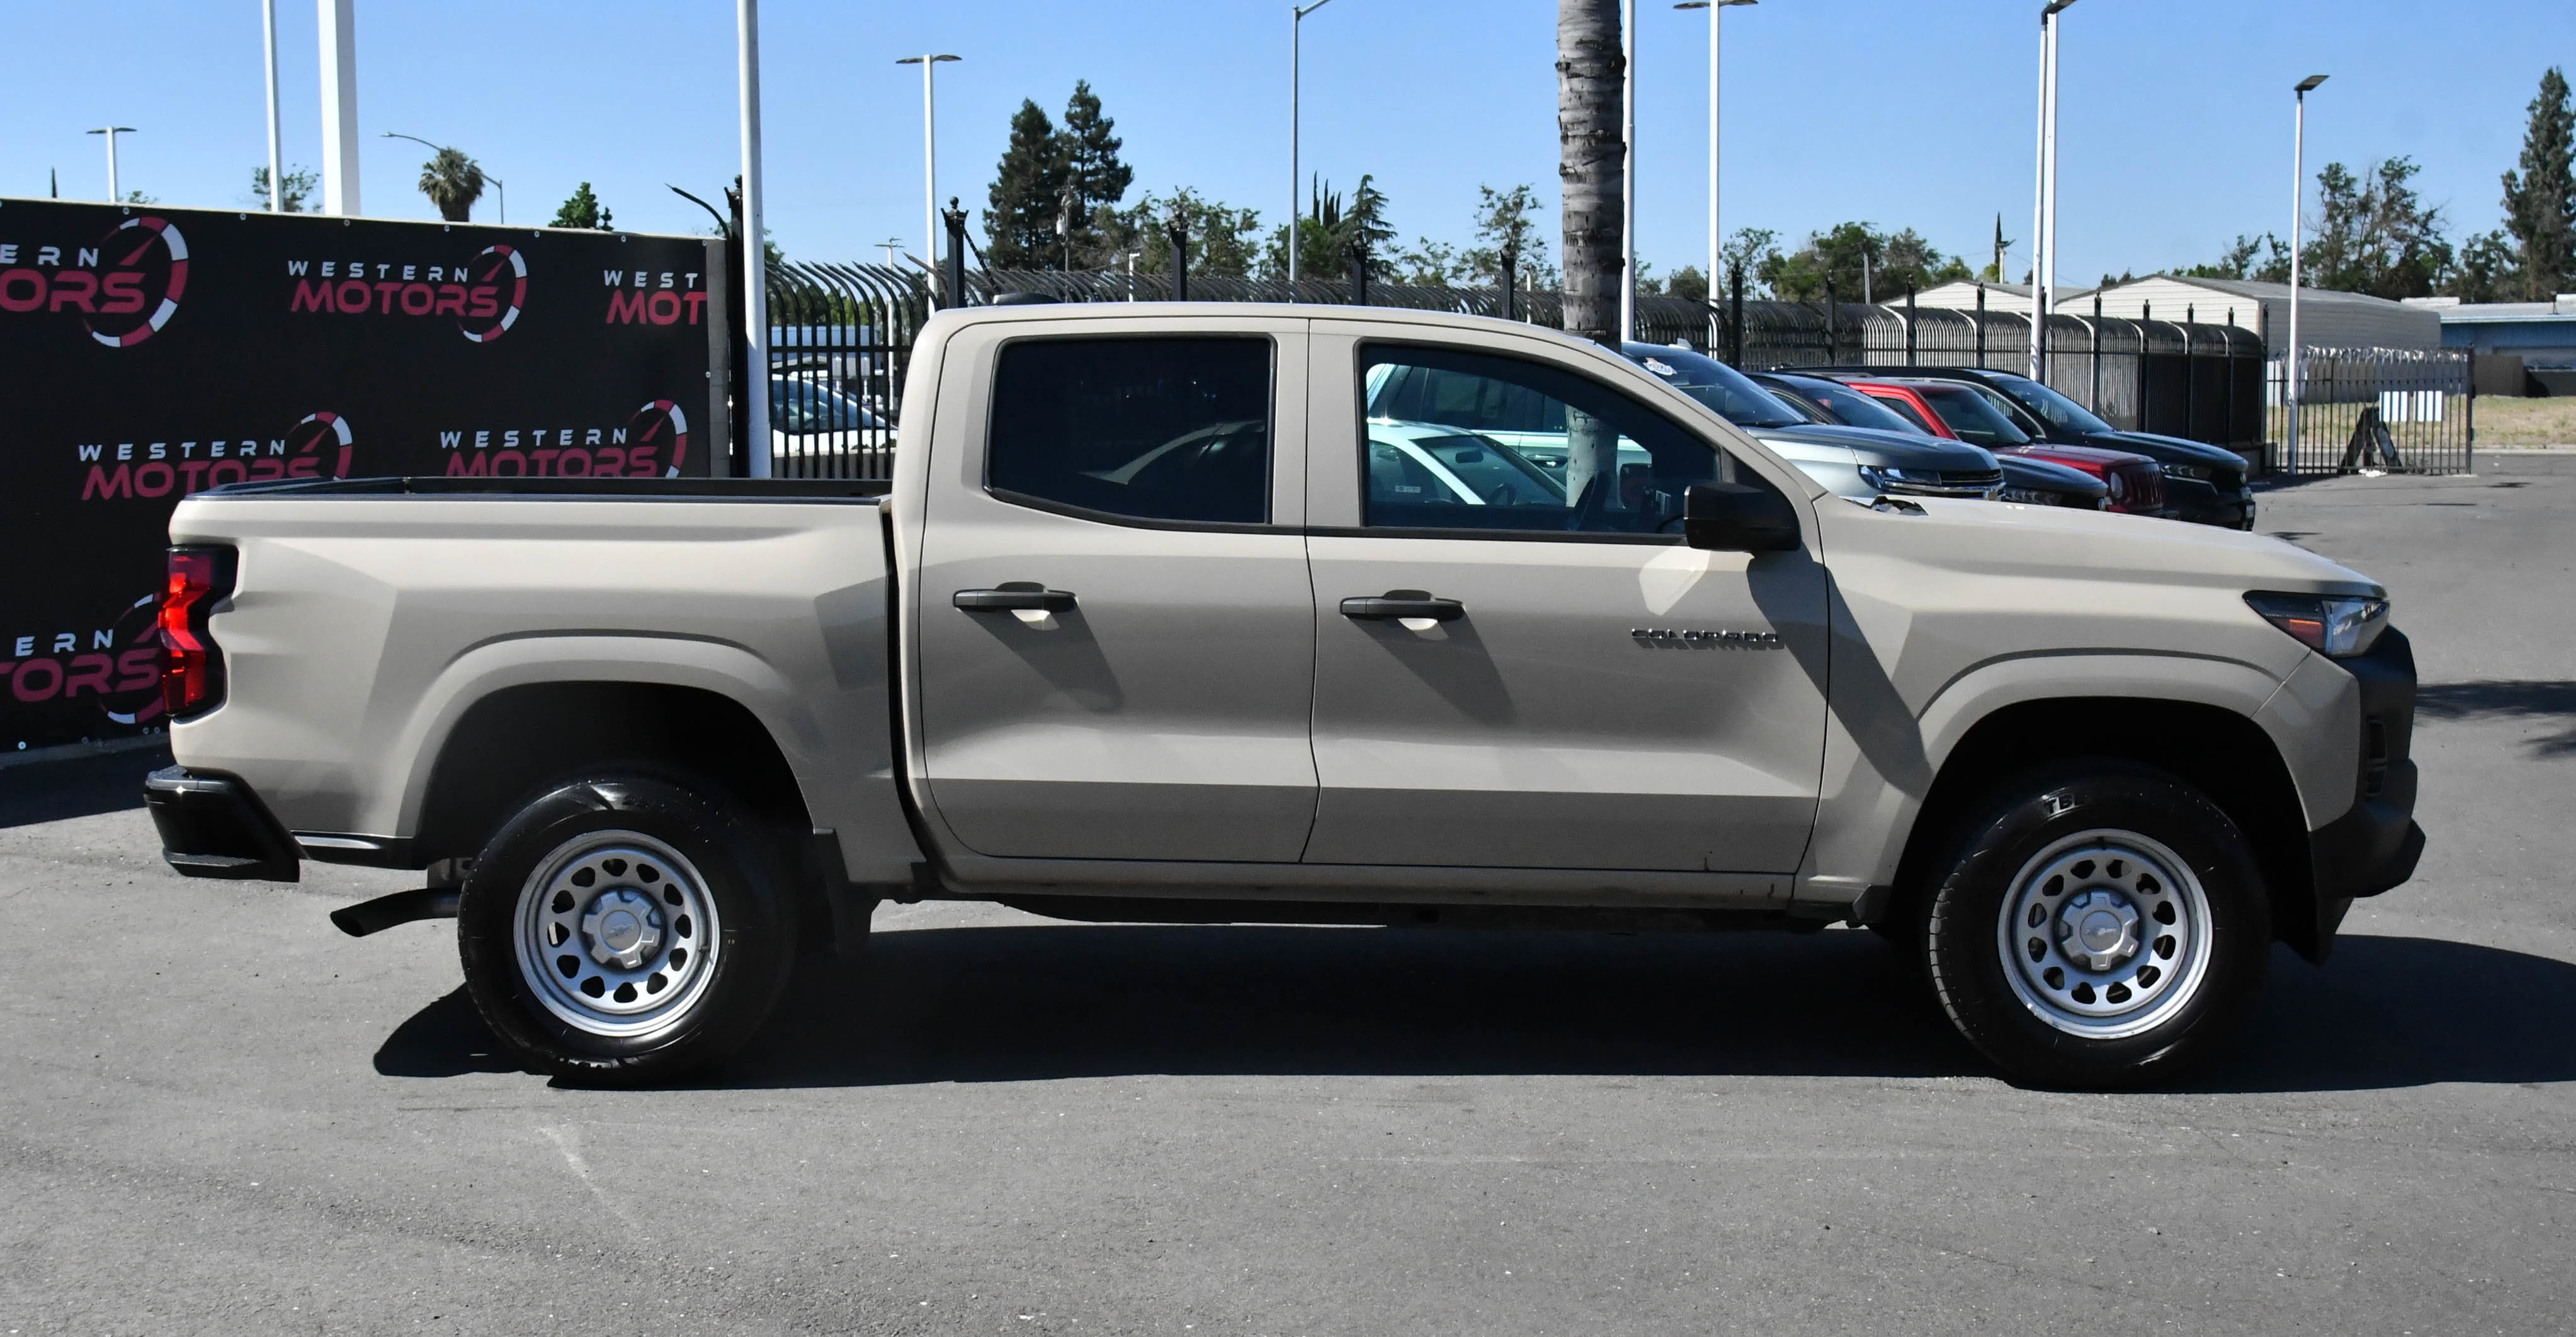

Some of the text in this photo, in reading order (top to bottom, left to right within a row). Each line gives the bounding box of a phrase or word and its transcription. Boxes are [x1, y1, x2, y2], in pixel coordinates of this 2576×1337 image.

[0, 244, 98, 266] ERN
[288, 260, 468, 282] WESTERN
[604, 270, 698, 288] WEST
[290, 279, 498, 317] MOTORS
[606, 289, 707, 325] MOT
[441, 428, 627, 448] WESTERN
[79, 440, 285, 461] WESTERN
[446, 447, 658, 477] MOTORS
[15, 629, 113, 656] ERN
[1631, 629, 1779, 642] COLORADO
